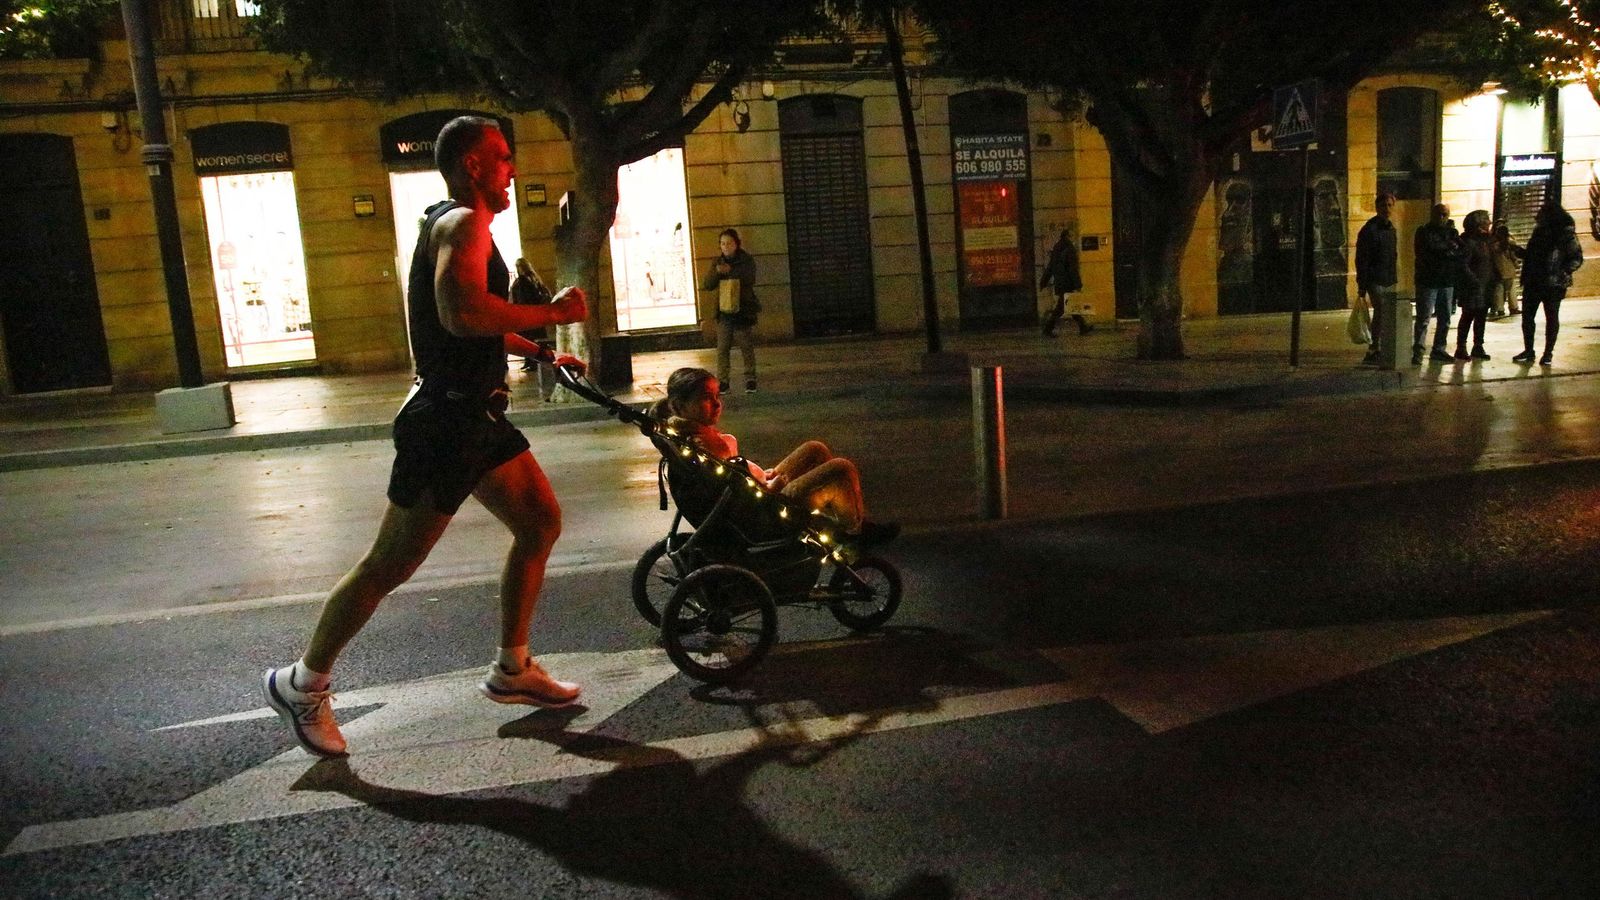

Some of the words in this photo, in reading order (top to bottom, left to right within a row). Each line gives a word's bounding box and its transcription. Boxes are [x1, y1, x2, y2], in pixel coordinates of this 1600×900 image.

[962, 136, 995, 144] HABITA
[996, 135, 1024, 143] STATE
[397, 141, 436, 154] wom
[196, 151, 289, 167] women'secret
[955, 150, 971, 161] SE
[974, 148, 1025, 160] ALQUILA
[955, 161, 978, 173] 606
[980, 160, 1002, 172] 980
[1005, 159, 1026, 171] 555
